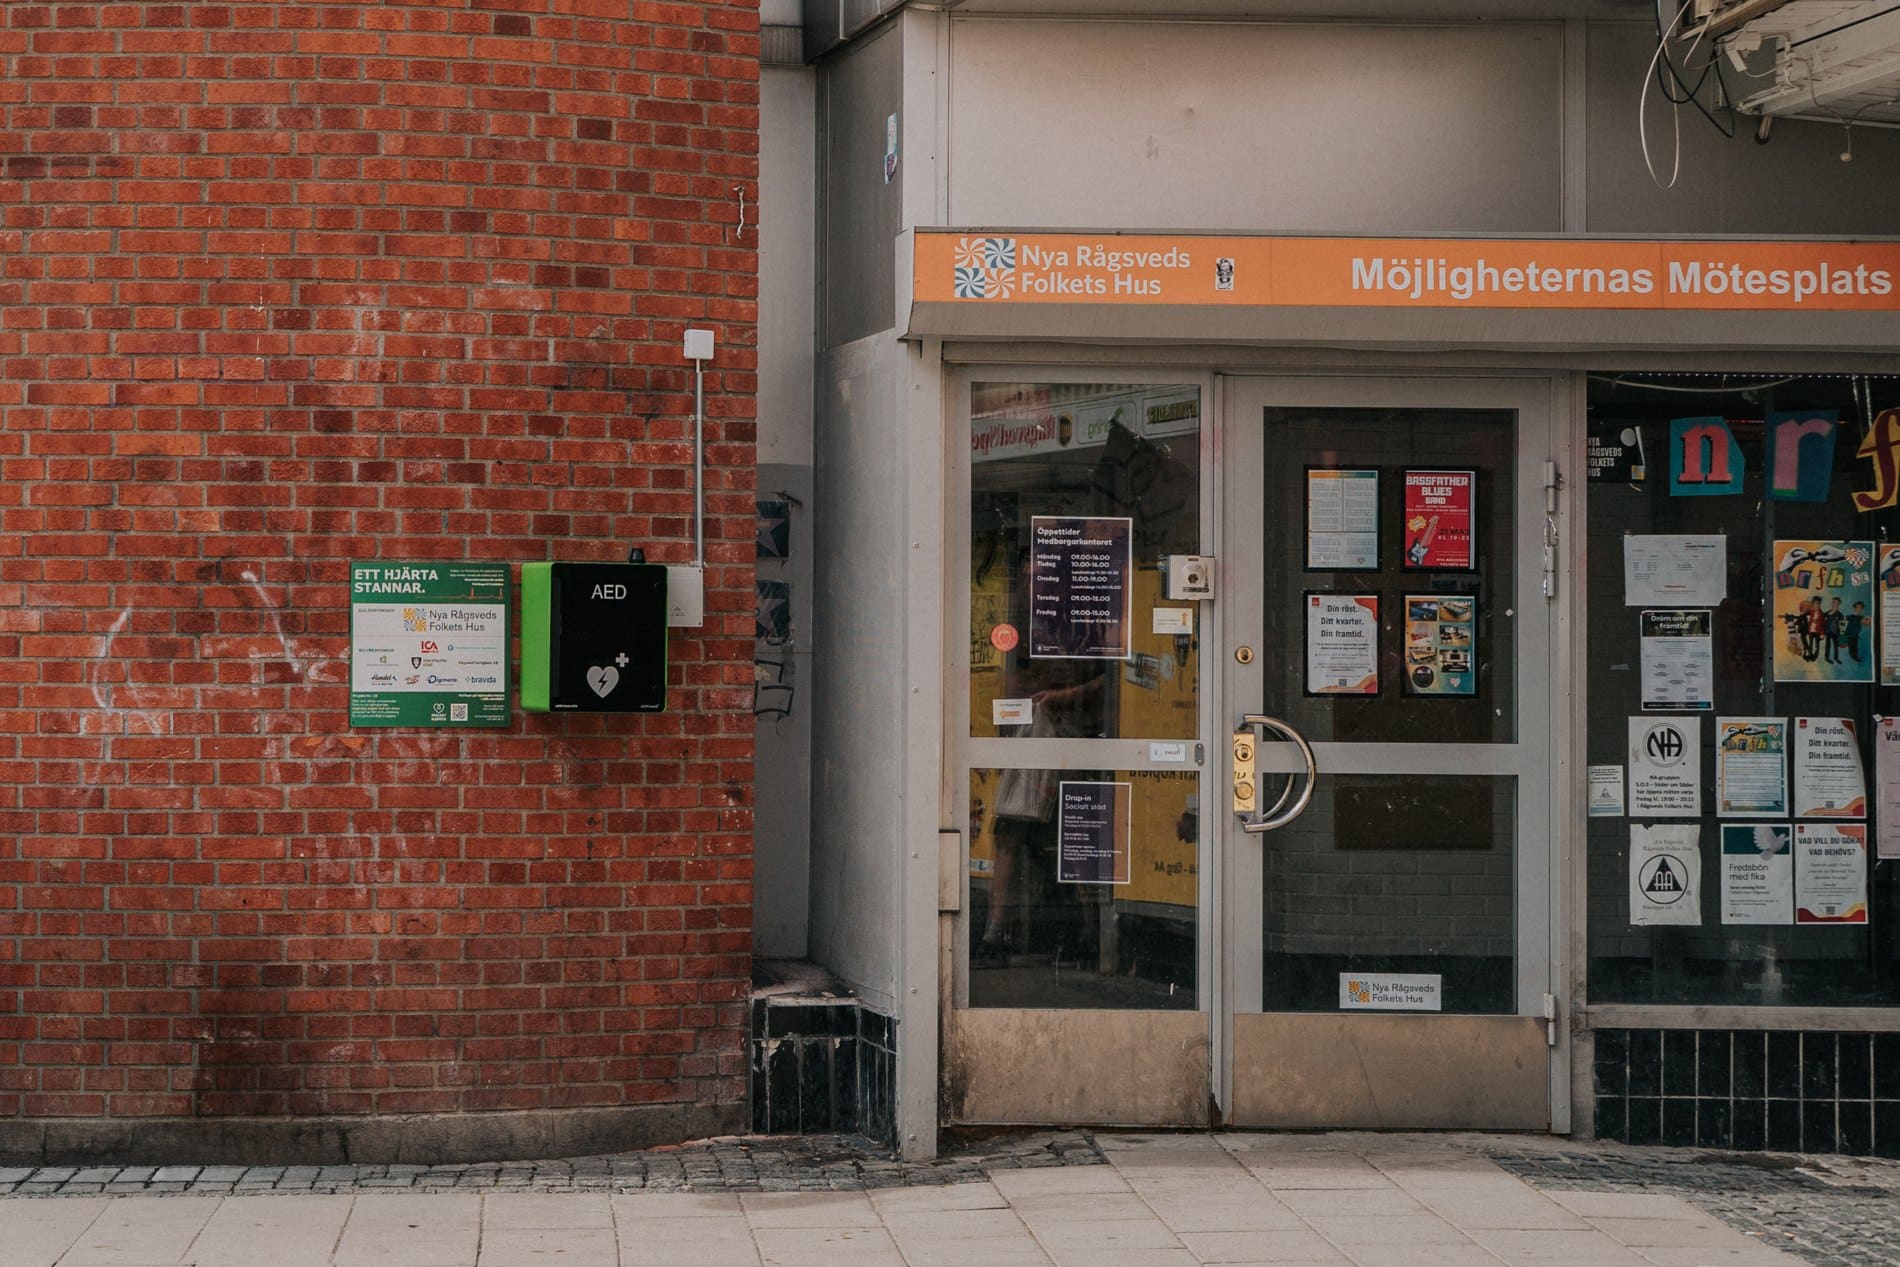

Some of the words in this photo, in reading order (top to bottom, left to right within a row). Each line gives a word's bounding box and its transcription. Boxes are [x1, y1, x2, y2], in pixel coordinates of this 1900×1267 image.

[1022, 245, 1068, 271] Nya
[1077, 244, 1190, 272] Rågsveds
[1022, 272, 1106, 295] Folkets
[1114, 274, 1162, 295] Hus
[1352, 258, 1653, 299] Möjligheternas
[1669, 260, 1892, 301] Mötesplats
[1406, 476, 1469, 486] BASSFATHER
[1421, 486, 1452, 496] BLUES
[1037, 527, 1081, 537] Öppettider
[1037, 538, 1113, 547] Medborgarkontoret
[354, 569, 380, 581] ETT
[384, 566, 438, 581] HJÄRTA
[354, 582, 425, 593] STANNAR.
[591, 584, 627, 599] AED
[1327, 604, 1339, 612] Din
[429, 610, 448, 620] Nya
[451, 609, 497, 621] Rågsveds
[1321, 617, 1333, 625] Ditt
[1336, 617, 1364, 625] kvarter.
[429, 622, 462, 632] Folkets
[466, 623, 485, 632] Hus
[1321, 630, 1333, 638] Din
[1335, 630, 1364, 638] framtid.
[421, 640, 438, 650] ICA
[471, 675, 496, 684] bravida
[1815, 727, 1827, 735] Din
[1647, 727, 1683, 762] NA
[1809, 752, 1821, 760] Din
[1065, 794, 1092, 802] Drop-in
[1809, 848, 1822, 856] VAD
[1825, 848, 1856, 856] BEHÖVS?
[1729, 863, 1768, 872] Fredsbön
[1656, 871, 1673, 890] AA
[1372, 983, 1389, 993] Nya
[1392, 983, 1435, 993] Rågsveds
[1372, 994, 1403, 1003] Folkets
[1406, 995, 1424, 1003] Hus
